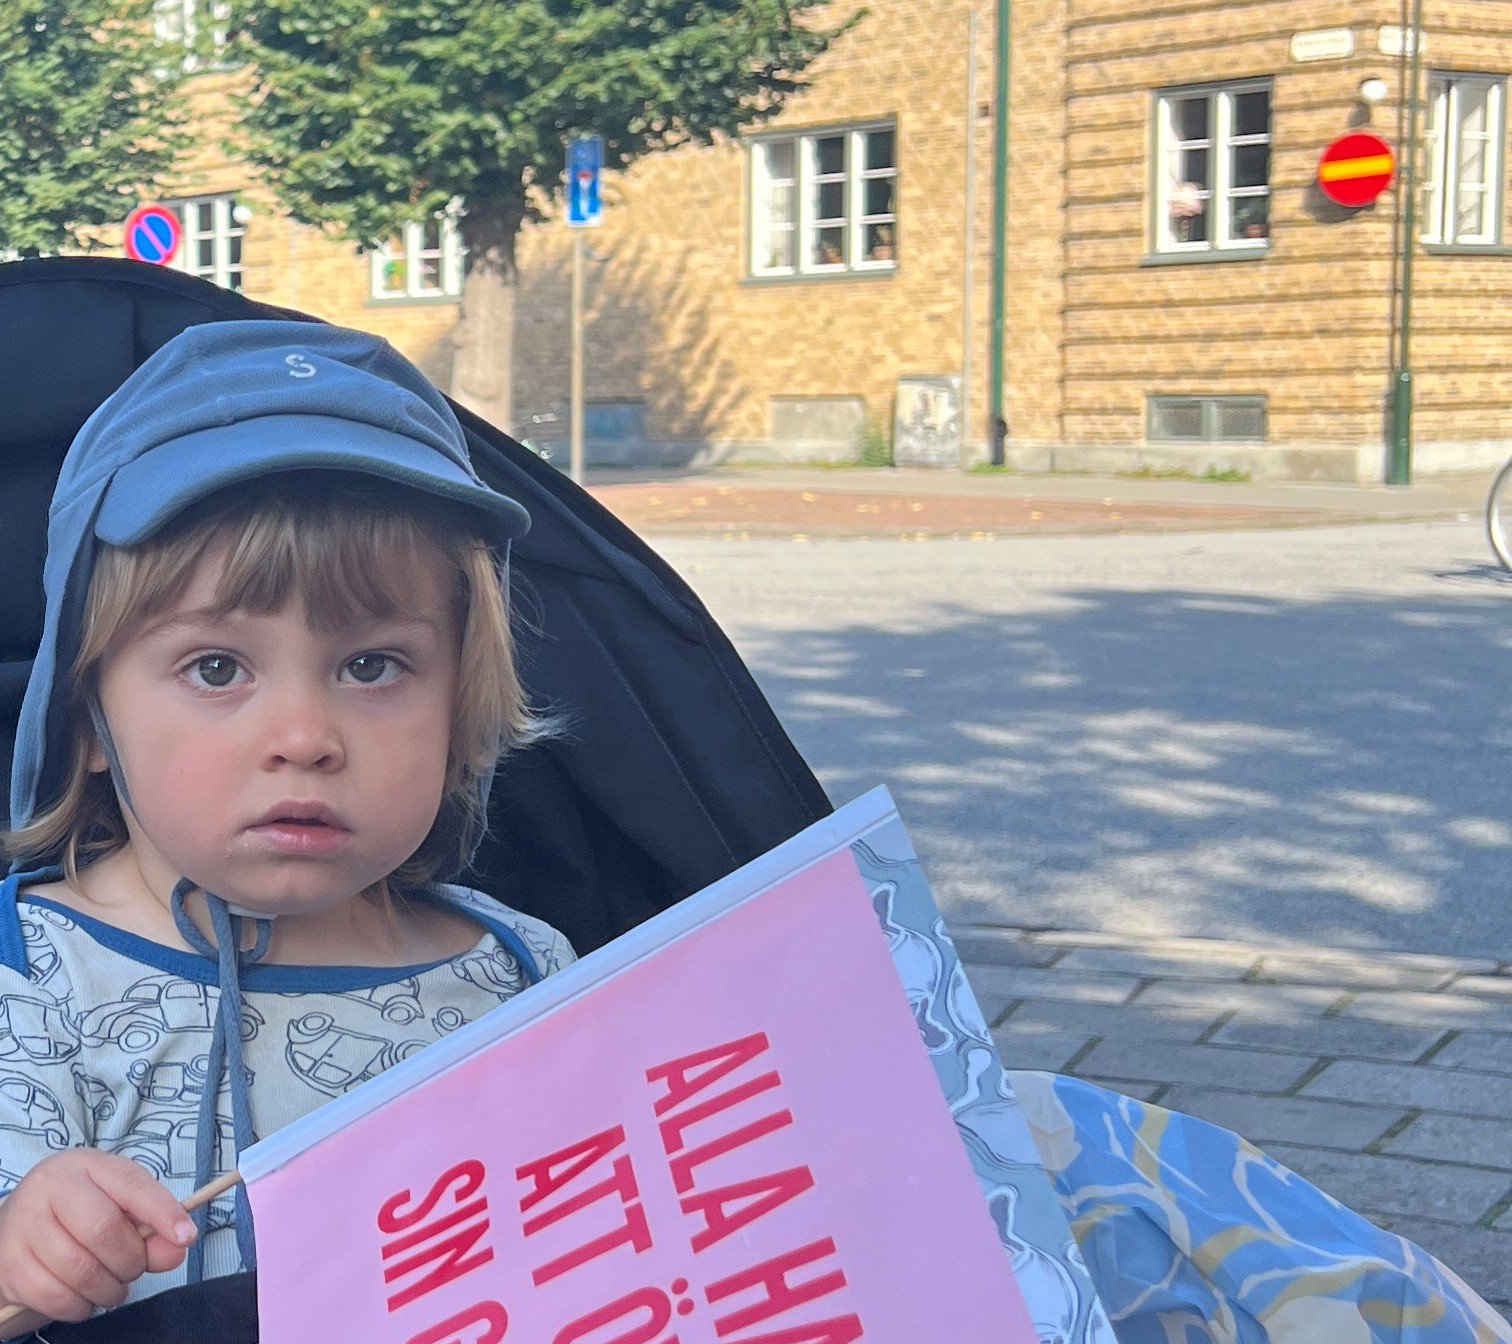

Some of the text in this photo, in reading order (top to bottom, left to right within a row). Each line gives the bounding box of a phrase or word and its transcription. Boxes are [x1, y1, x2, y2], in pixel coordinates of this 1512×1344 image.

[285, 354, 317, 379] S
[514, 1123, 654, 1288] ATT
[645, 1031, 815, 1254] ALLA
[376, 1158, 496, 1313] SIN
